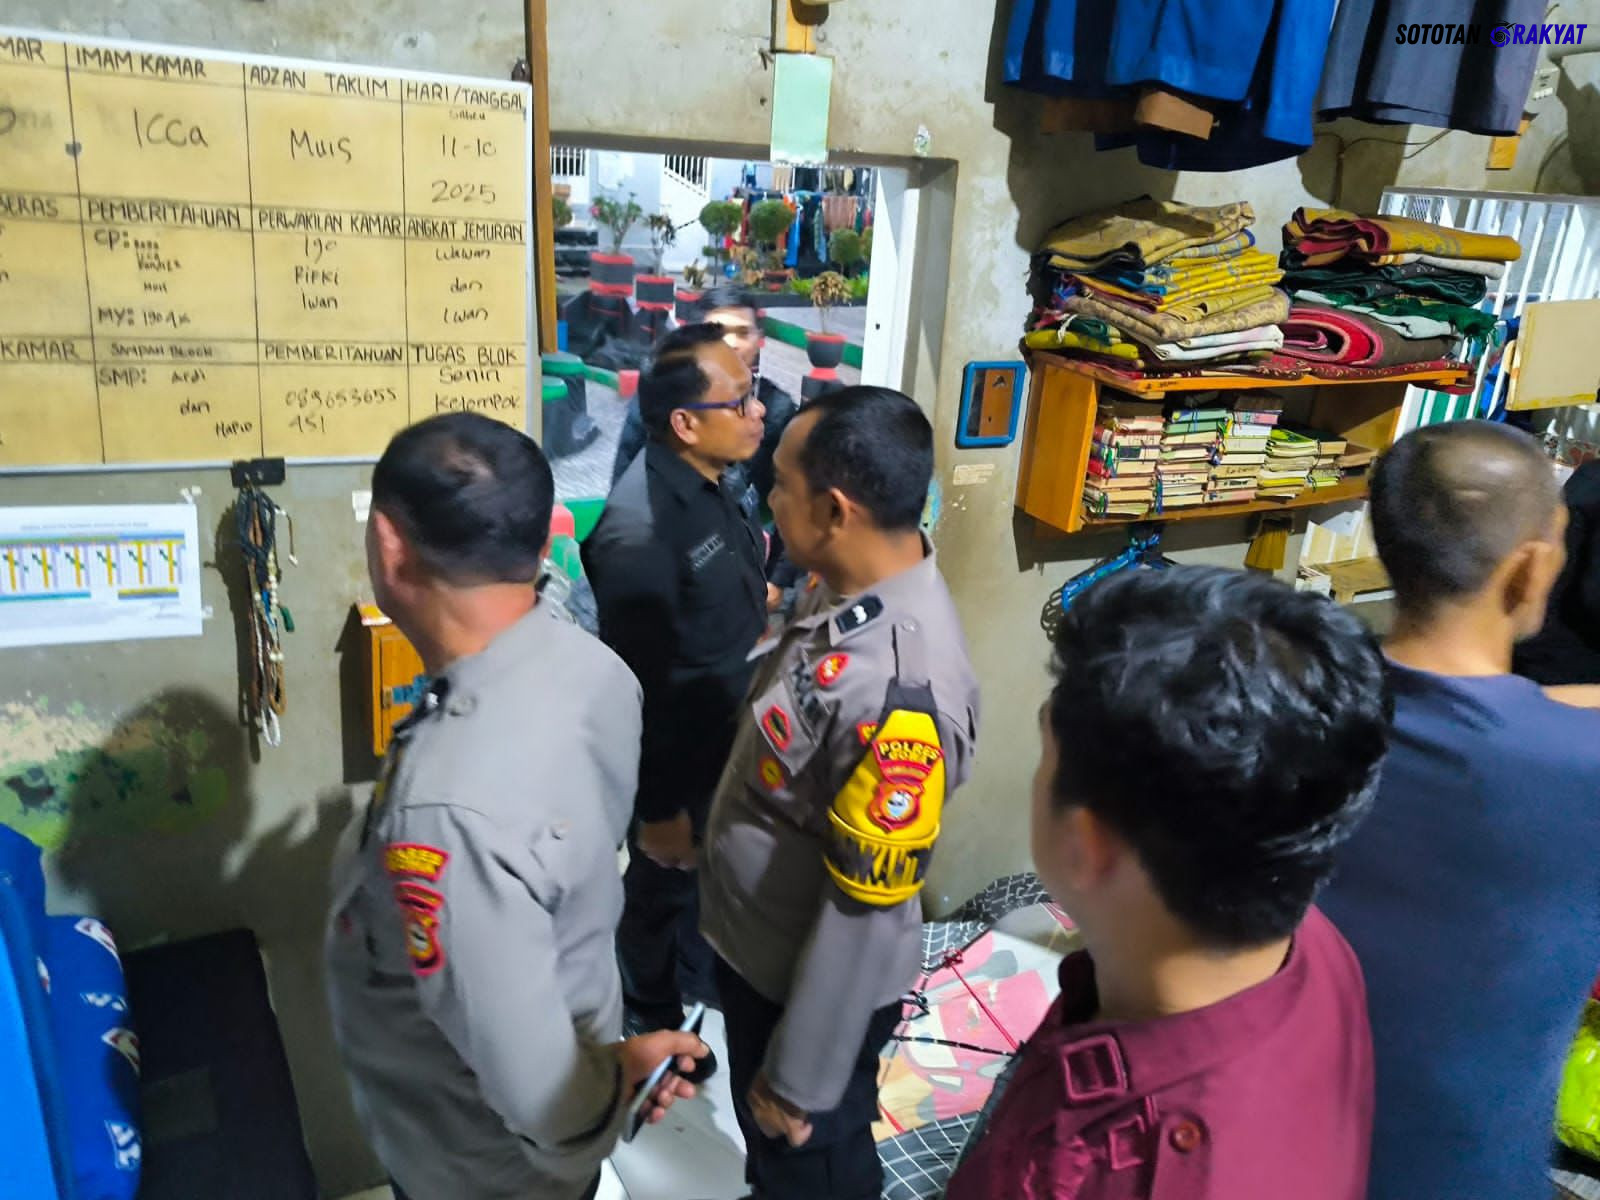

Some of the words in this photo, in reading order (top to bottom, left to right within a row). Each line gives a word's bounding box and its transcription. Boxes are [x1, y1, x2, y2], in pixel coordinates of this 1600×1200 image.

[76, 46, 133, 72] IMAM
[141, 53, 206, 79] KAMAR
[250, 65, 306, 89] ADZAN
[325, 72, 389, 97] TAKLIM
[431, 179, 496, 205] 2025
[88, 200, 241, 229] PEMBERITAHUAN
[258, 208, 342, 232] PERWAKILAN
[350, 214, 401, 235] KAMAR
[407, 214, 456, 239] ANGKAT
[461, 221, 523, 242] JEMURAN
[1, 340, 80, 361] KAMAR
[264, 343, 401, 361] PEMBERITAHUAN
[411, 343, 466, 363] TUGAS
[477, 348, 518, 366] BLOK
